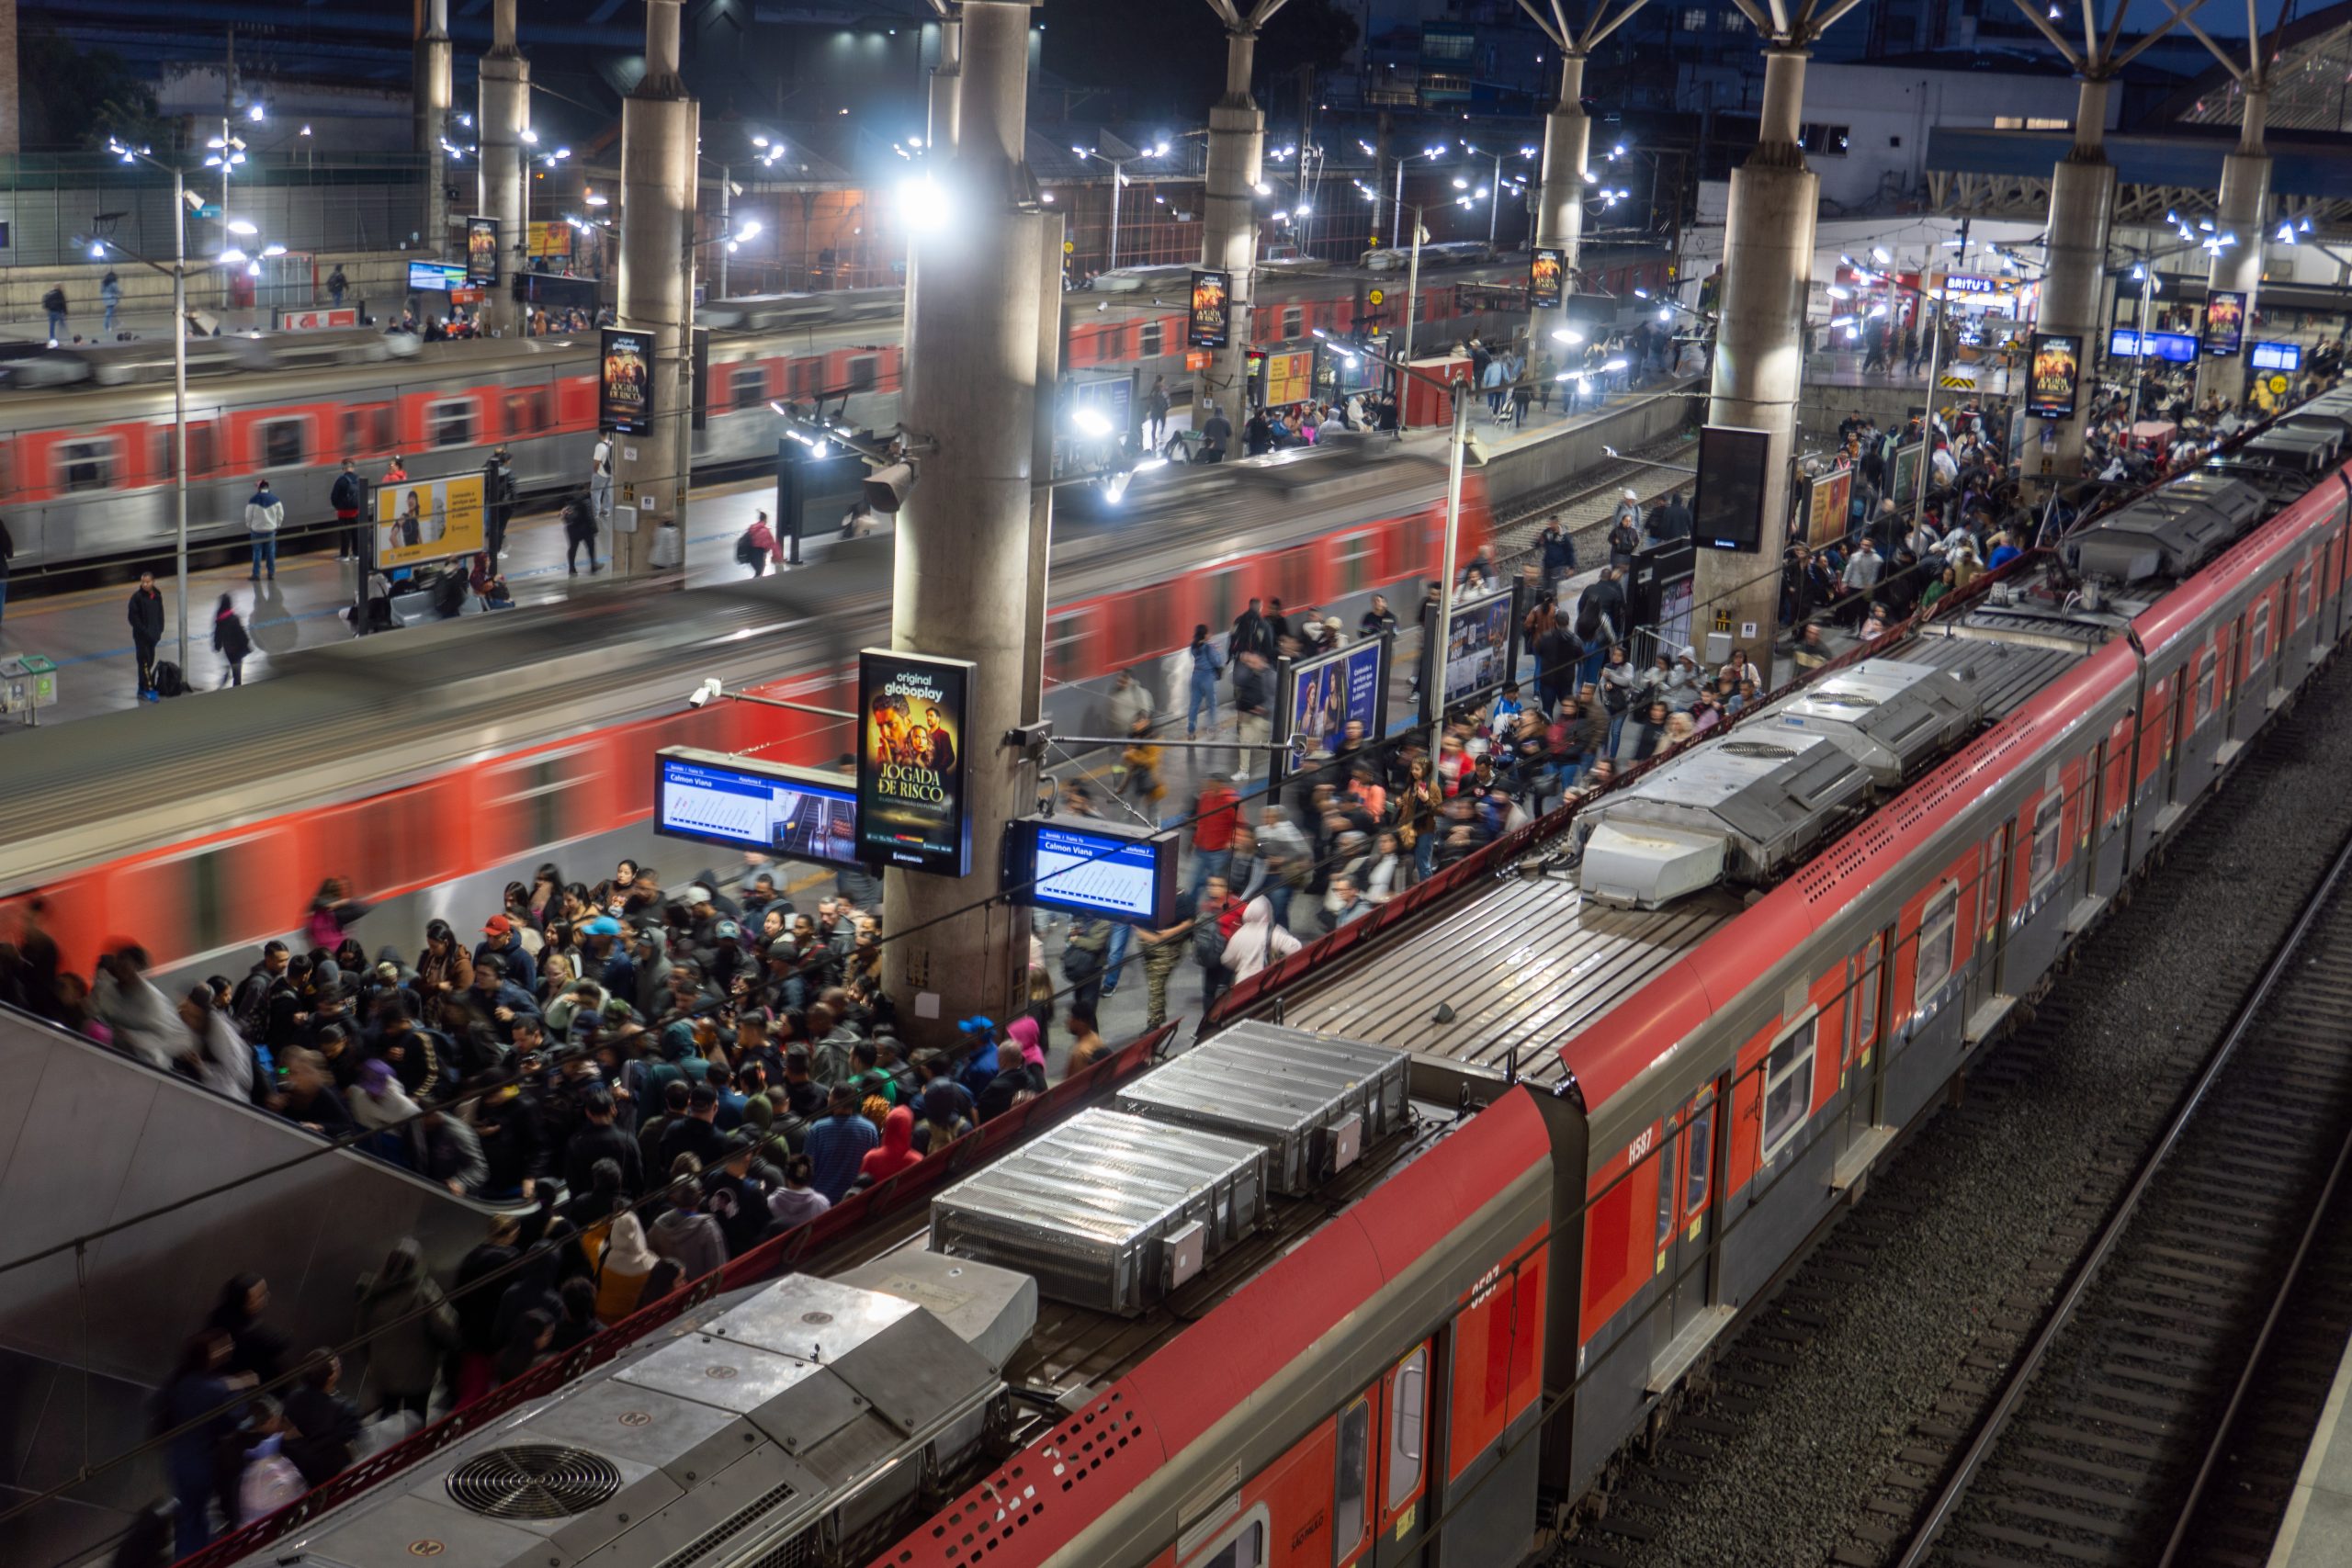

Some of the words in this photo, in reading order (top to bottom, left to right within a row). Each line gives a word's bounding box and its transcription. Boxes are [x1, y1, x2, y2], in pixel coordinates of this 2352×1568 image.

[1948, 277, 1991, 291] BRITU'S
[897, 672, 932, 686] original
[885, 682, 943, 704] globoplay
[670, 773, 694, 784] Calmon
[695, 776, 712, 787] Viana
[881, 763, 940, 786] JOGADA
[878, 779, 897, 795] DE
[899, 781, 944, 803] RISCO
[1045, 841, 1071, 853] Calmon
[1072, 846, 1093, 857] Viana
[1629, 1127, 1652, 1166] H587
